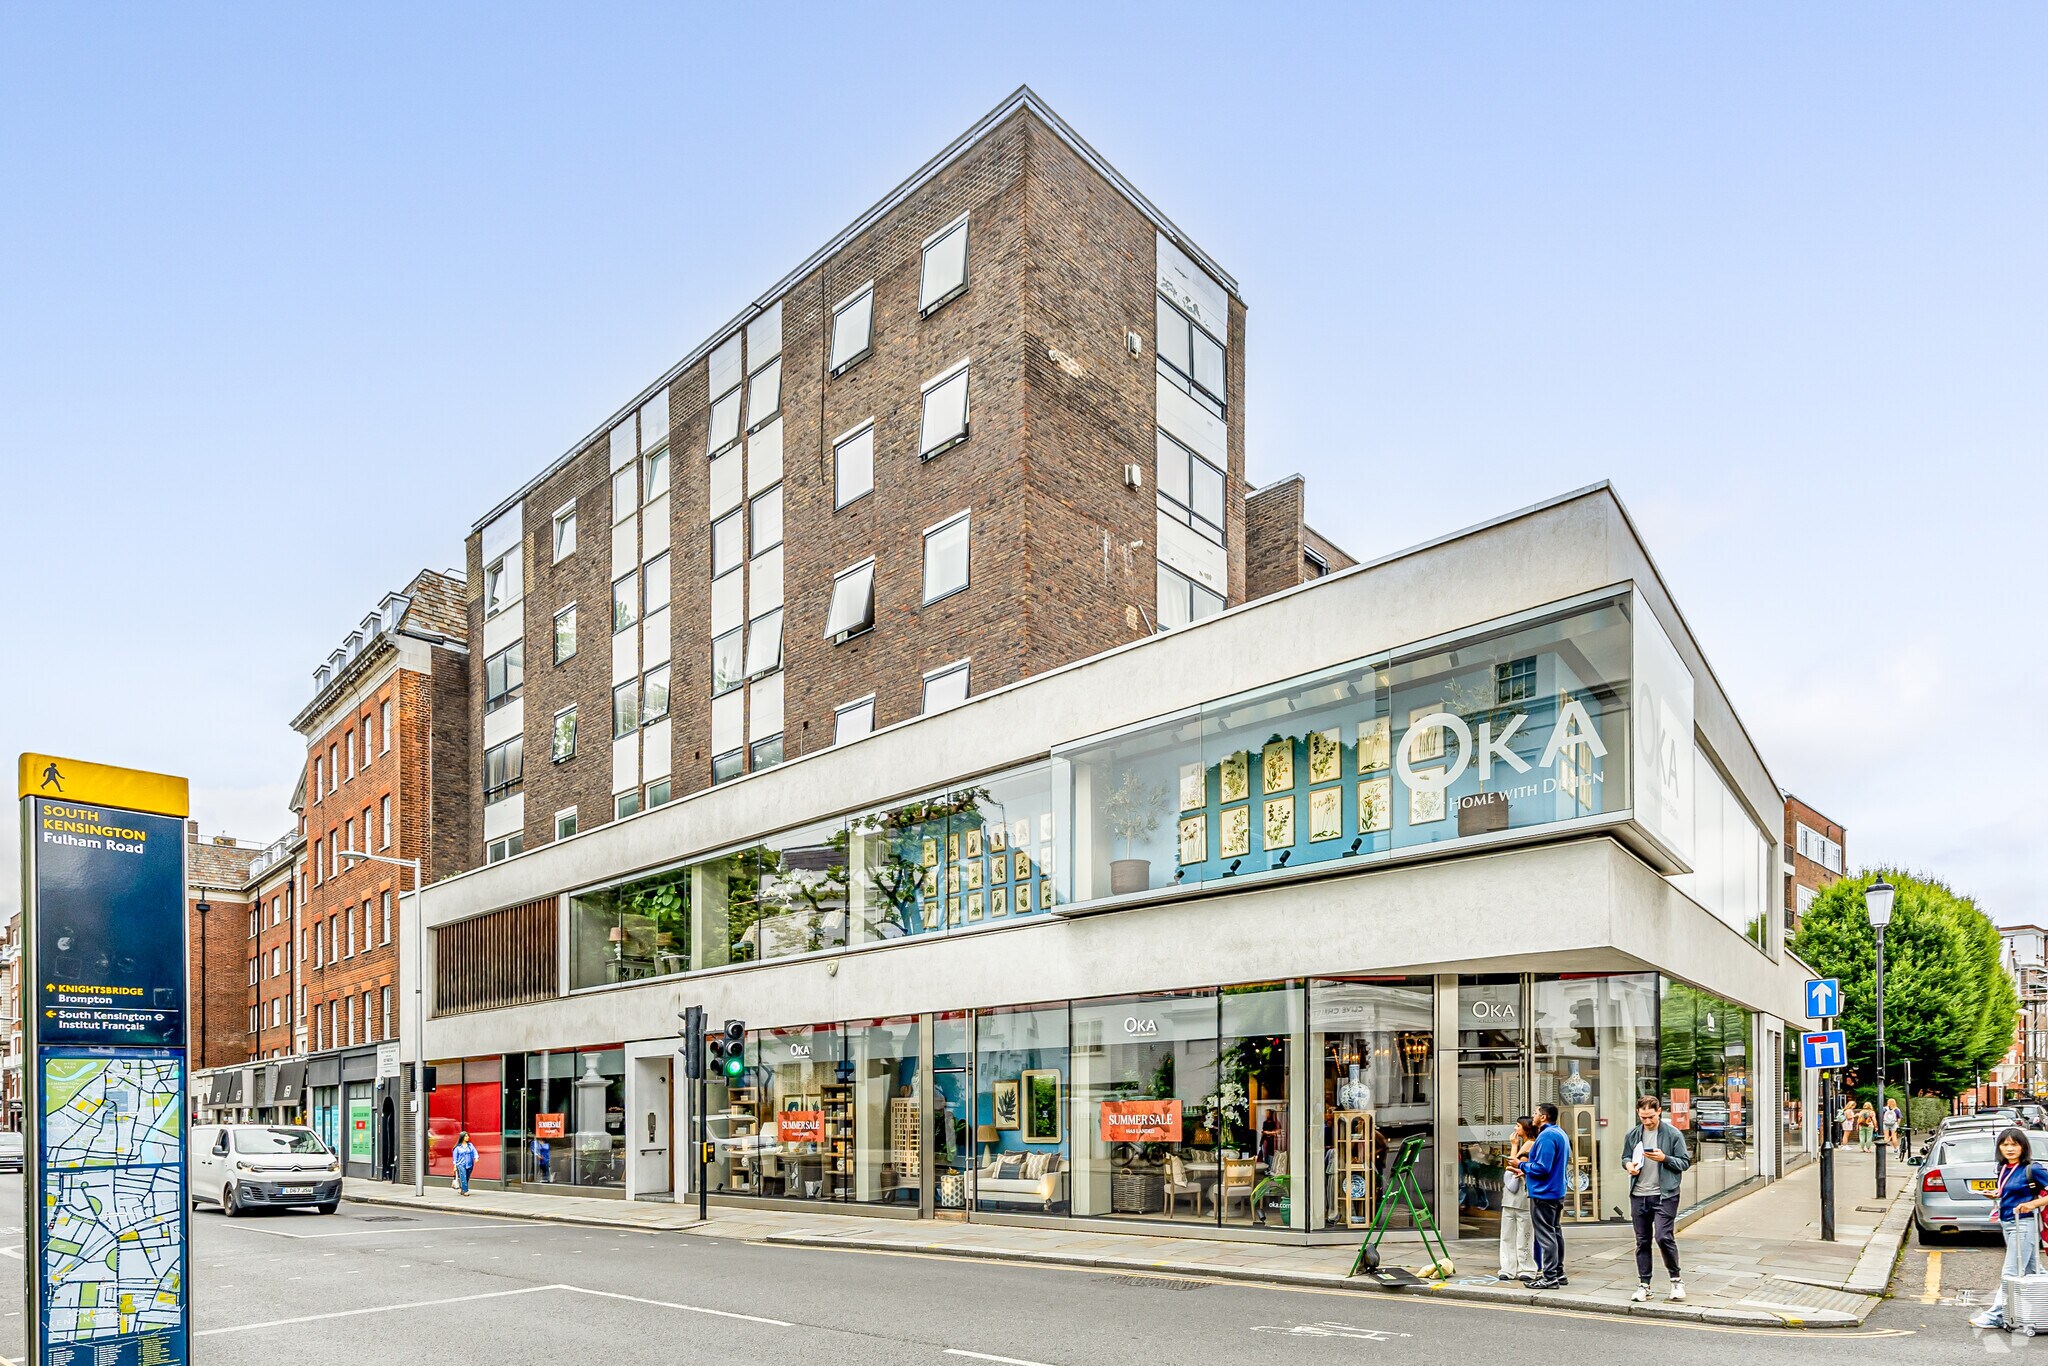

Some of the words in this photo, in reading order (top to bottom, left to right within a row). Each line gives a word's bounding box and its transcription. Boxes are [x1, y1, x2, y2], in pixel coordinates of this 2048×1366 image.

[1396, 700, 1608, 792] OKA
[1449, 793, 1495, 811] HOME
[1498, 783, 1537, 801] WITH
[1543, 771, 1604, 794] DEIGN
[43, 805, 99, 822] SOUTH
[43, 819, 146, 841] KENSINGTON
[43, 832, 101, 849] Fulham
[106, 840, 144, 854] Road
[58, 984, 144, 996] KNIGHTSBRIDGE
[58, 994, 113, 1004] Brompton
[58, 1010, 91, 1020] South
[94, 1011, 152, 1022] Kensington
[1472, 1001, 1516, 1018] OKA
[58, 1020, 100, 1030] Institut
[102, 1021, 145, 1032] Français
[1123, 1017, 1157, 1033] OKA
[790, 1043, 810, 1056] OKA
[806, 1120, 820, 1129] SALE
[1108, 1114, 1148, 1125] SUMMER
[1149, 1113, 1173, 1125] SALE
